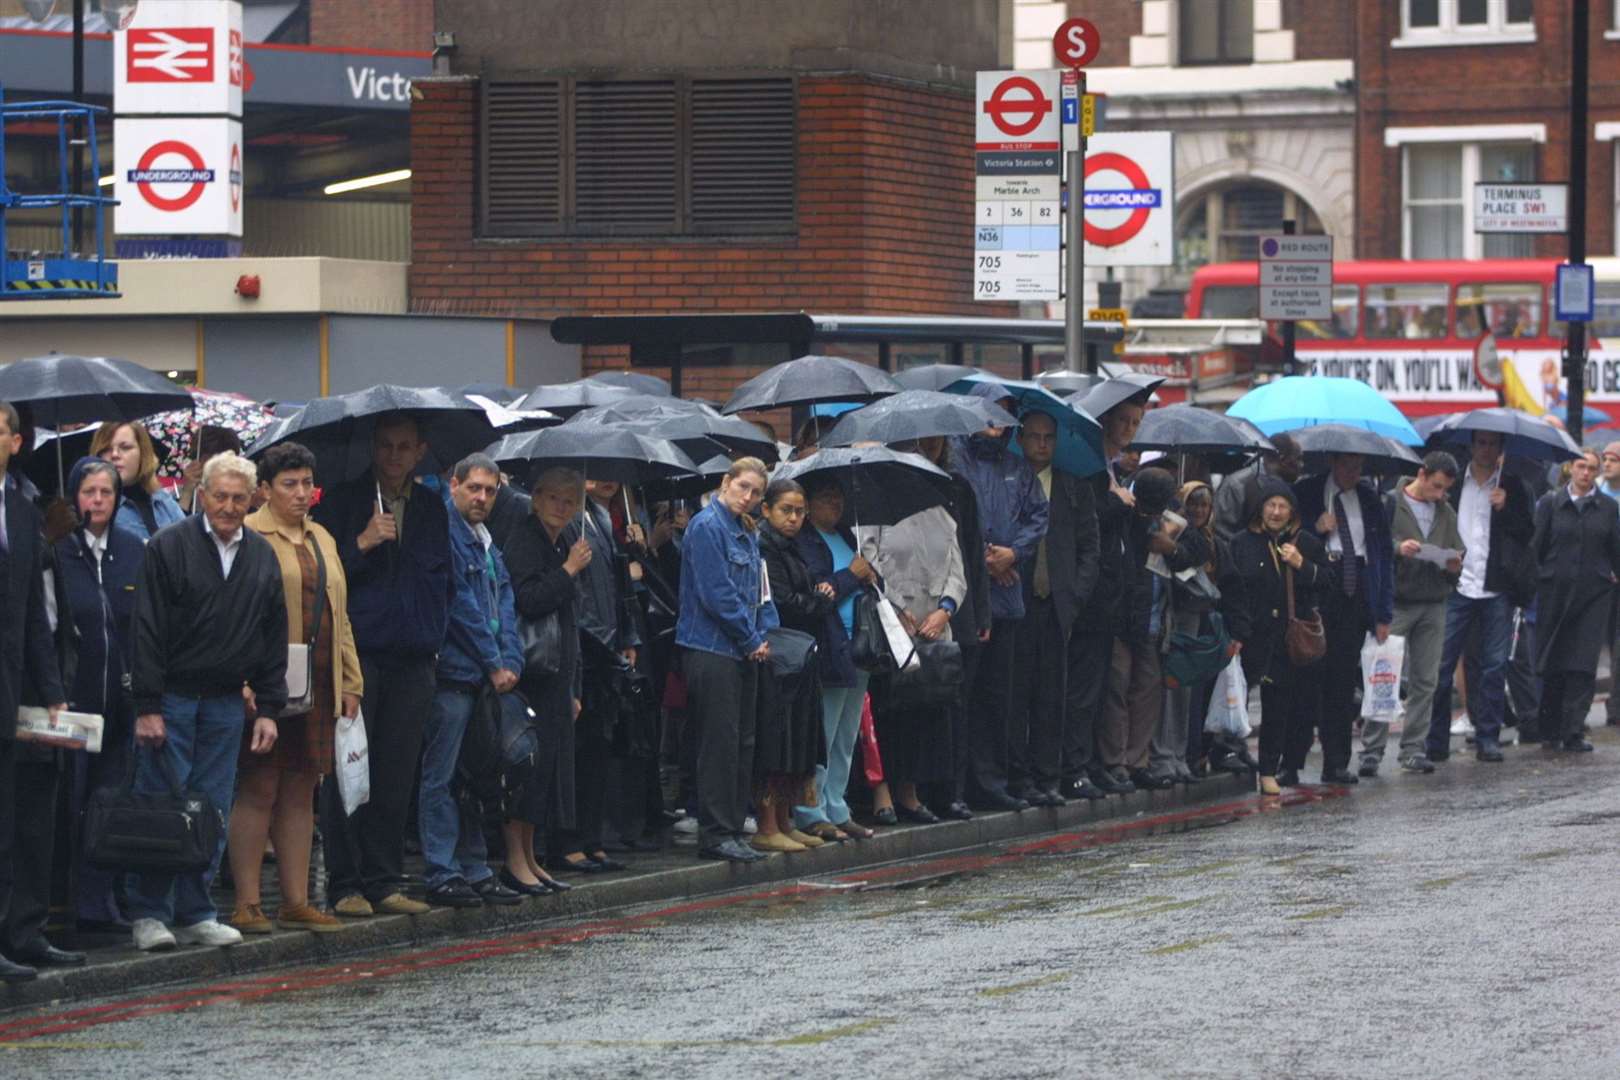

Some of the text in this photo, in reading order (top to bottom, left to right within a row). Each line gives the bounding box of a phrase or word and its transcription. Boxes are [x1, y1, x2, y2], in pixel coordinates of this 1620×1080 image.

[1066, 26, 1086, 59] S
[1066, 103, 1075, 120] 1
[984, 159, 1044, 168] Victoria Station
[131, 170, 212, 181] UNDERGROUND
[994, 186, 1041, 195] Marble Arch
[1483, 188, 1542, 200] TERMINUS
[1084, 194, 1156, 206] ERGROUND
[985, 207, 1052, 217] 2 36 82
[1482, 202, 1547, 214] PLACE SW1
[978, 232, 999, 242] N36
[1281, 244, 1329, 252] RED ROUTE
[979, 256, 1001, 268] 705
[1272, 264, 1319, 274] No stopping
[978, 281, 1001, 293] 705
[1272, 289, 1320, 298] Except taxis
[1281, 298, 1321, 307] authorised
[1284, 308, 1307, 316] times
[1375, 358, 1400, 392] ON,
[1402, 358, 1452, 391] YOU'LL
